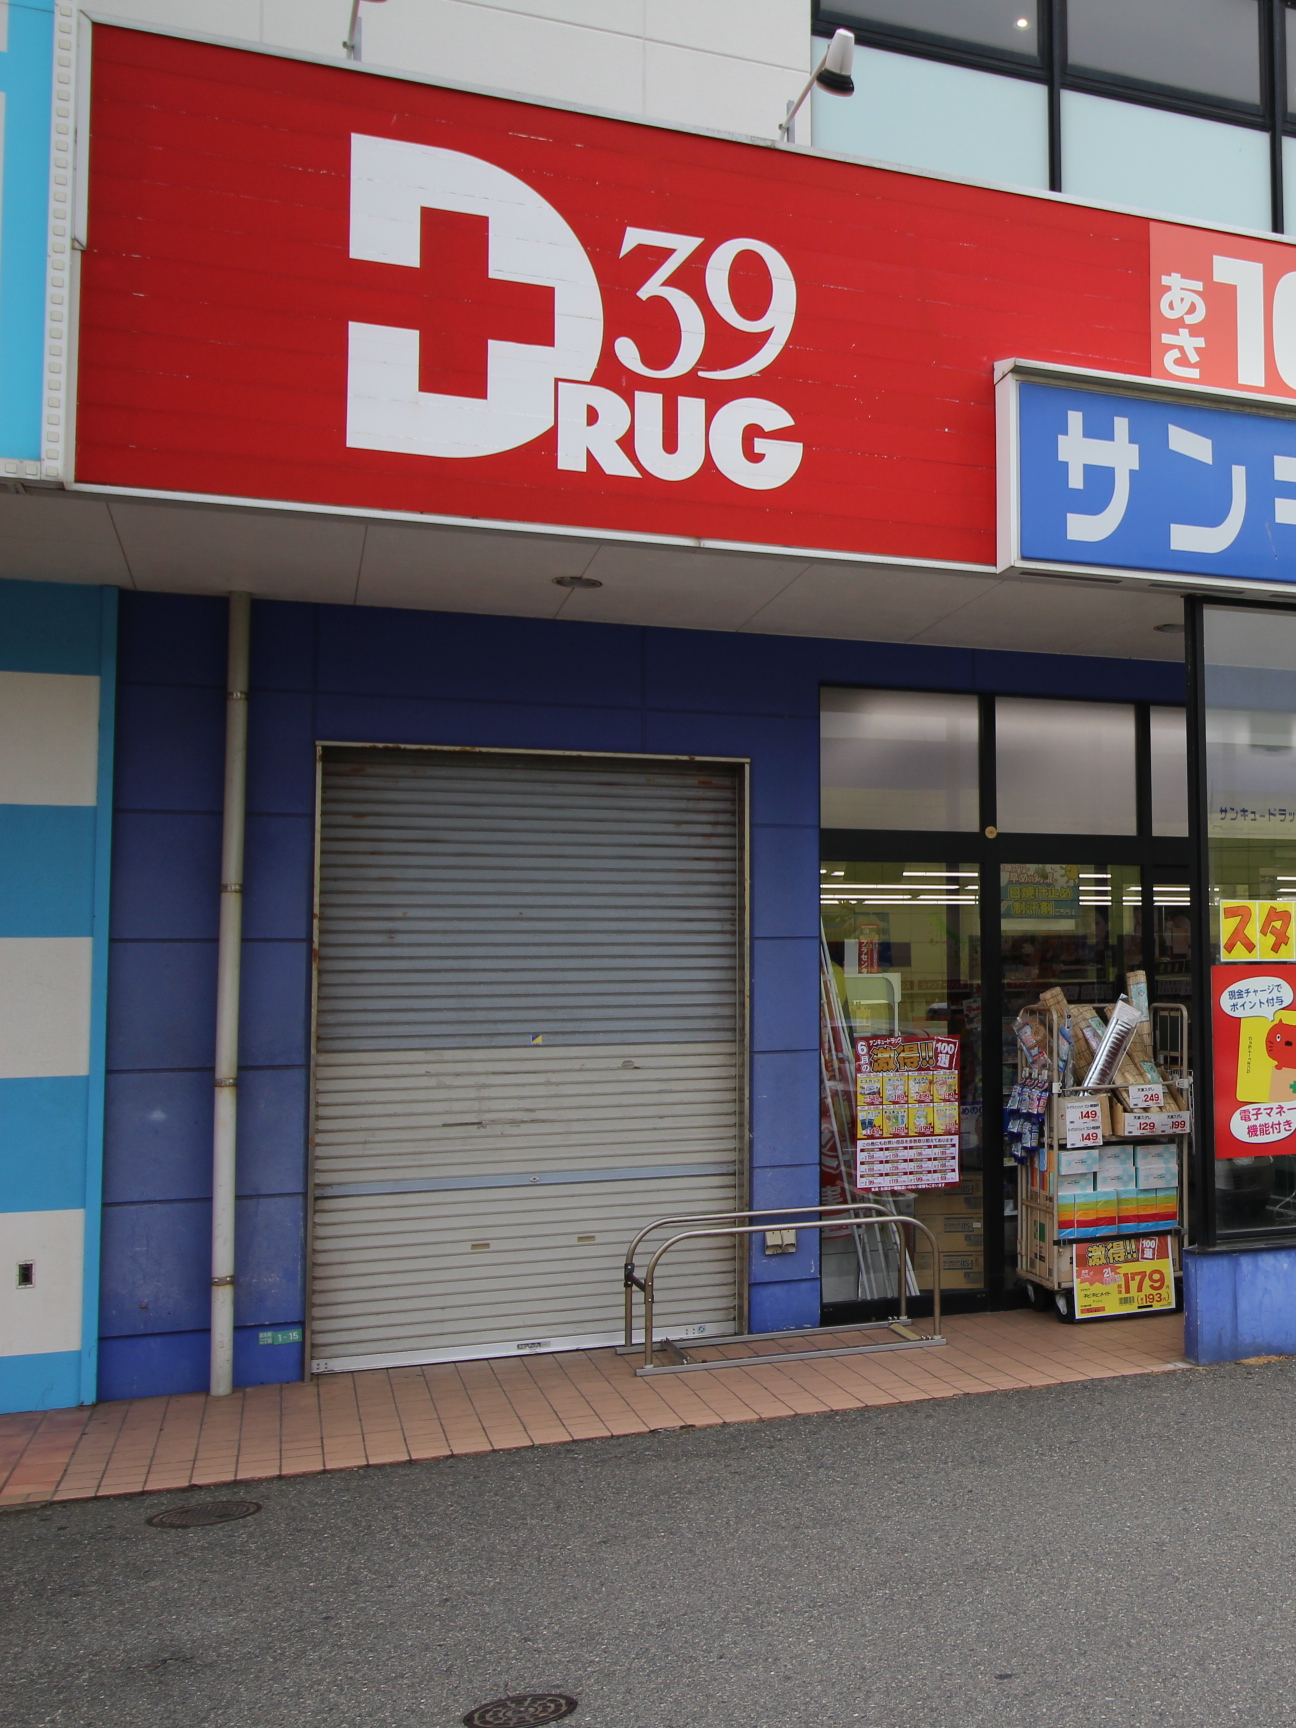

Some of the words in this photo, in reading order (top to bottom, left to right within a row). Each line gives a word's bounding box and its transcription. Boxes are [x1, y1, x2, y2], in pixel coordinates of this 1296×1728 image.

[614, 227, 797, 380] 39
[1009, 885, 1072, 900] 日焼け止め
[1228, 983, 1283, 1000] 現金チャージで
[1229, 996, 1284, 1013] ポイント付与
[857, 1041, 870, 1072] 6月の
[1143, 1093, 1159, 1102] 249
[1080, 1110, 1097, 1120] 149
[1138, 1122, 1155, 1131] 129
[1171, 1120, 1186, 1129] 199
[1247, 1120, 1293, 1138] 機能付き
[1081, 1132, 1098, 1142] 149
[277, 1331, 299, 1342] 1-15
